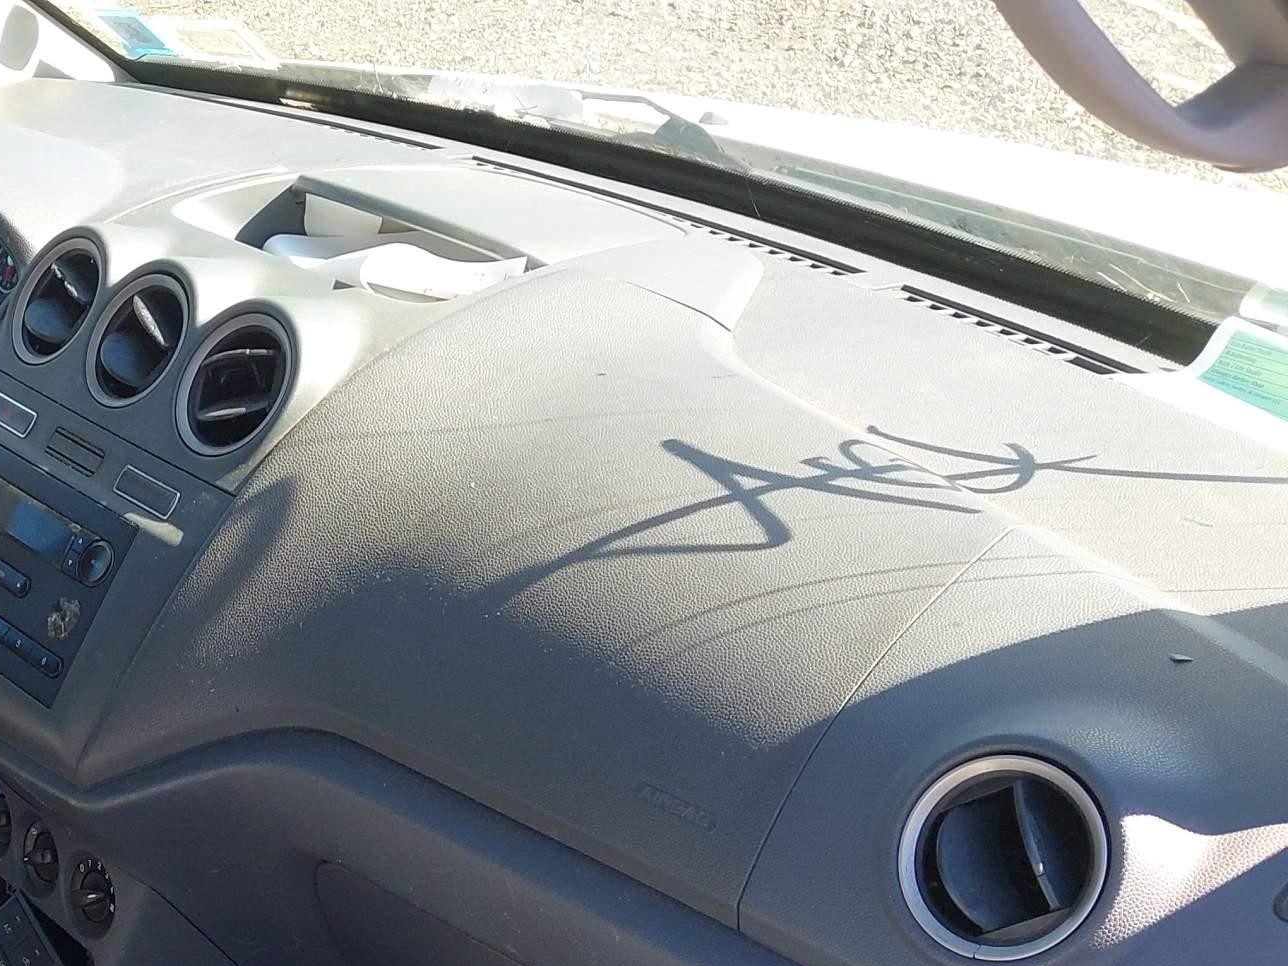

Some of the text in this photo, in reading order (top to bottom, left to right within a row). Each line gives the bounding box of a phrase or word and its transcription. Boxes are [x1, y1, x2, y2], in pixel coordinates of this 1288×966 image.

[79, 863, 85, 873] 0
[87, 859, 92, 868] 1
[97, 861, 102, 871] 2
